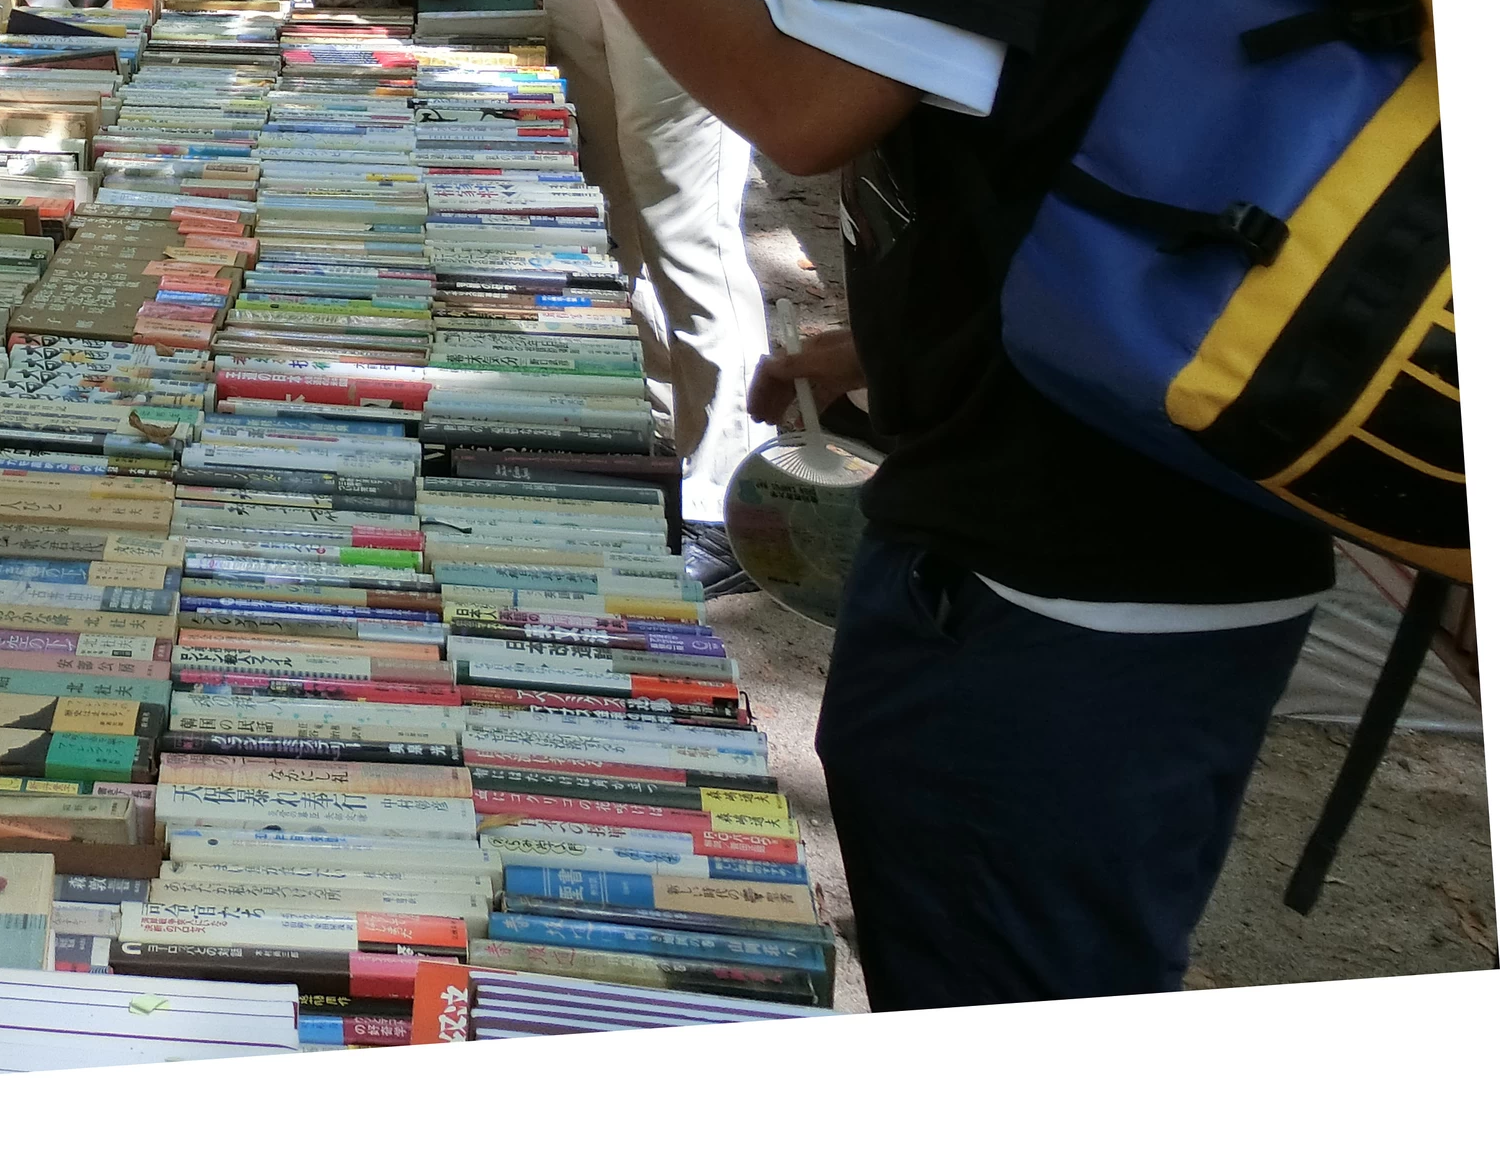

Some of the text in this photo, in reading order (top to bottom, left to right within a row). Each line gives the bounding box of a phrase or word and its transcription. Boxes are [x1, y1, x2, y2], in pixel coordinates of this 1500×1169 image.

[83, 617, 147, 630] 北杜夫
[56, 658, 136, 673] 安部公房
[66, 682, 134, 697] 北杜夫
[180, 717, 275, 734] 韓国の民話
[267, 768, 349, 783] なかにし礼
[172, 784, 450, 813] 天保暴れ奉行 中村彰彦
[473, 790, 664, 818] 血にコクリコの花咲けば
[140, 902, 266, 920] 司令官たち
